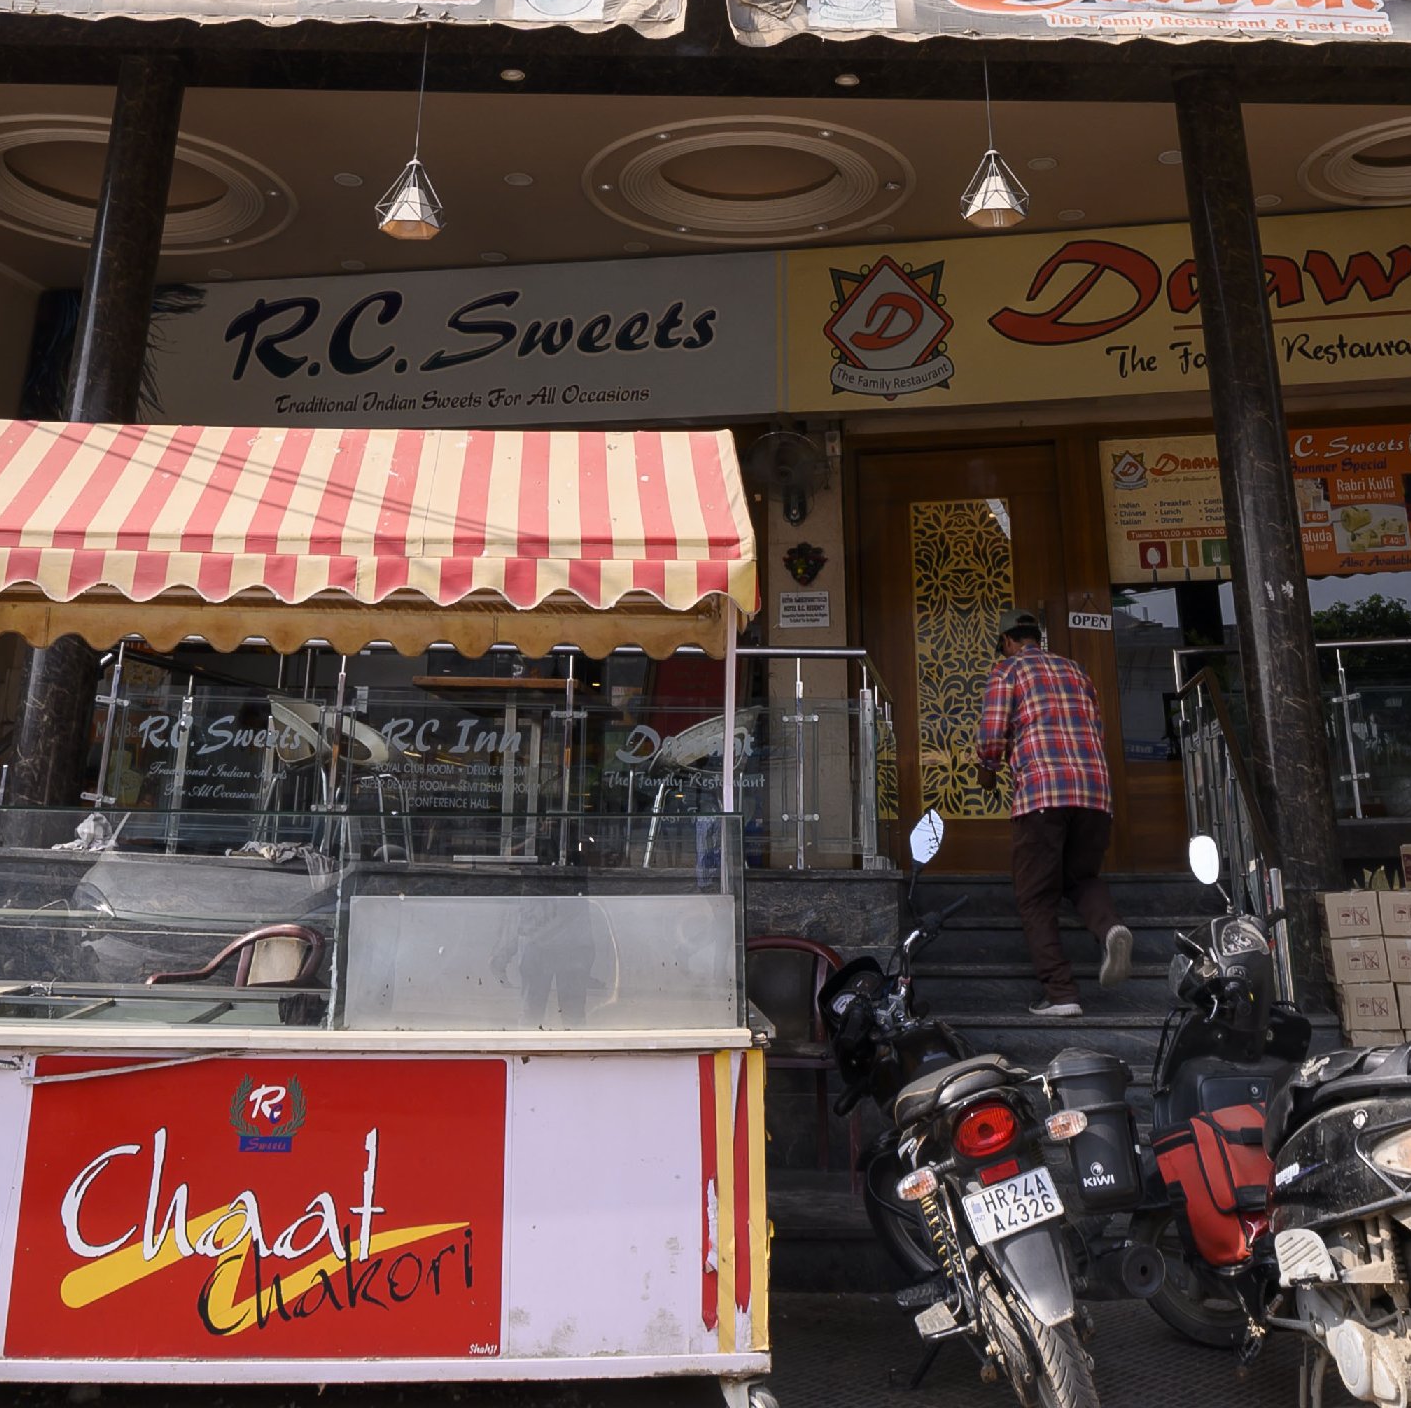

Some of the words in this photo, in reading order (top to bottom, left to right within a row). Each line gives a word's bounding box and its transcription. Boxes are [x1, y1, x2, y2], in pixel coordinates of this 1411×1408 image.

[1048, 13, 1085, 29] The
[1089, 15, 1156, 33] Family
[1160, 16, 1266, 31] Restaurant
[1275, 18, 1288, 31] &
[1296, 19, 1335, 33] Fast
[1342, 21, 1389, 36] Food
[224, 290, 408, 381] R.C.
[420, 290, 718, 372] Sweets
[1105, 343, 1158, 378] The
[836, 367, 855, 385] The
[857, 372, 892, 392] Family
[893, 363, 950, 390] Restaurant
[275, 392, 359, 414] Traditional
[362, 391, 416, 413] Indian
[421, 390, 482, 412] Sweets
[487, 388, 521, 408] For
[526, 386, 557, 407] All
[561, 383, 650, 405] Occasions
[1323, 436, 1405, 459] Sweets
[1149, 453, 1221, 477] DAAW
[1340, 457, 1387, 474] Special
[1337, 478, 1366, 491] Rabri
[1368, 476, 1395, 490] Kulfi
[1159, 499, 1192, 508] Breakfast
[1119, 510, 1147, 518] Chinese
[1160, 508, 1181, 516] Lunch
[1120, 518, 1142, 526] Italian
[1160, 517, 1184, 525] Dinner
[1302, 529, 1333, 543] aluda
[1339, 556, 1365, 568] Also
[1071, 614, 1109, 629] OPEN
[380, 717, 442, 753] R.C.
[449, 718, 522, 754] Inn
[212, 763, 251, 778] Indian
[426, 765, 454, 775] ROOM
[419, 780, 447, 792] ROOM
[634, 771, 685, 792] Family
[688, 772, 766, 790] Restarant
[188, 783, 213, 798] All
[407, 797, 468, 808] CONFERENCE
[469, 798, 491, 809] HALL
[1082, 1174, 1116, 1188] KIWI
[60, 1126, 386, 1263] Chaat
[982, 1173, 1047, 1214] HR24A
[993, 1193, 1055, 1234] A4326
[197, 1223, 475, 1337] Chakori
